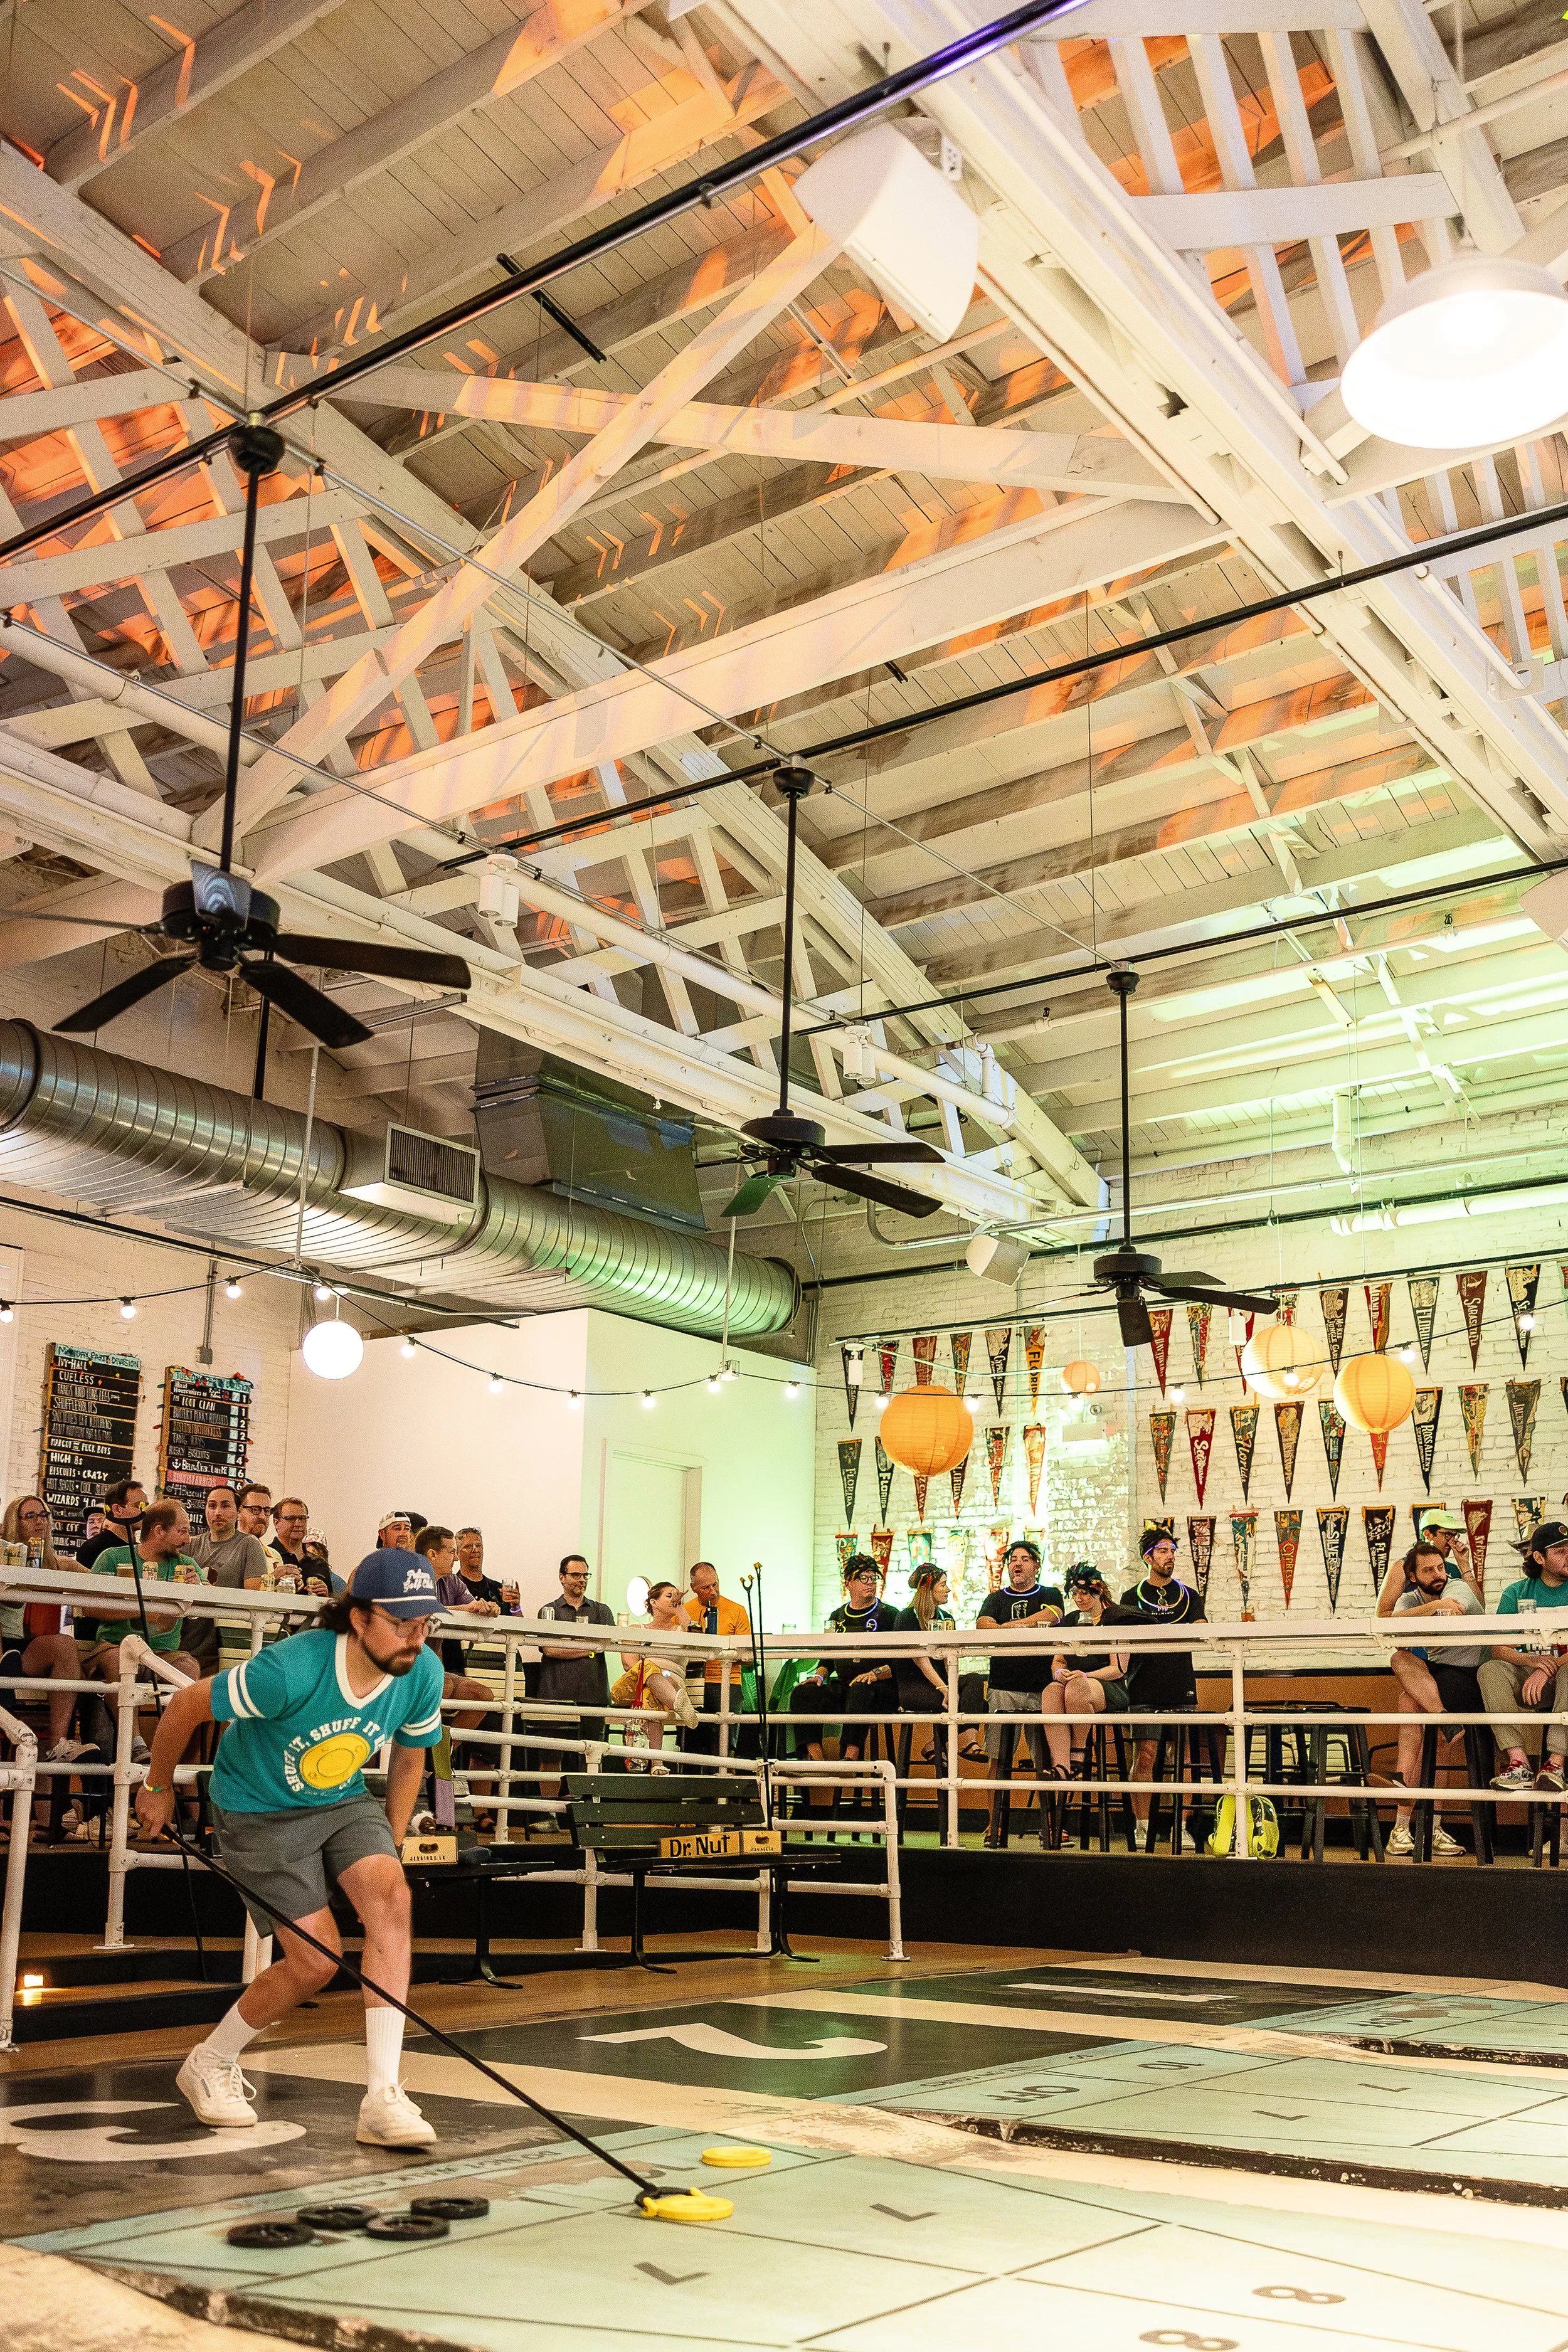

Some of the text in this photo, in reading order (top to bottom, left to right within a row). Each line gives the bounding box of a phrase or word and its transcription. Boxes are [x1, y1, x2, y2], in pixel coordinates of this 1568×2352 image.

[1371, 1286, 1380, 1310] MIAMI
[1327, 1320, 1338, 1342] JUNGLE
[59, 1371, 94, 1385] CUELESS
[993, 1355, 1006, 1380] CYPRS
[243, 1395, 246, 1403] 1
[241, 1408, 245, 1416] 1
[1421, 1424, 1434, 1444] ROSS
[50, 1452, 71, 1463] HIGH
[236, 1457, 242, 1465] 4
[1236, 1439, 1252, 1483] Florida
[82, 1470, 109, 1481] CRAZY
[238, 1470, 244, 1478] 6
[846, 1468, 856, 1507] FLORIDA
[879, 1473, 891, 1508] FLORIDA
[46, 1493, 80, 1506] WIZARDS
[1327, 1531, 1340, 1564] SILVER
[1283, 1543, 1295, 1582] CYPRESS
[1377, 1553, 1387, 1577] WALTON
[990, 1561, 1003, 1591] FLORI
[309, 1717, 361, 1741] SHUFF
[362, 1720, 380, 1737] IT
[696, 1835, 731, 1855] Nut
[574, 2022, 889, 2060] 2
[983, 2084, 1080, 2104] OFF
[1251, 2285, 1347, 2306] 8
[1138, 2328, 1241, 2352] 8
